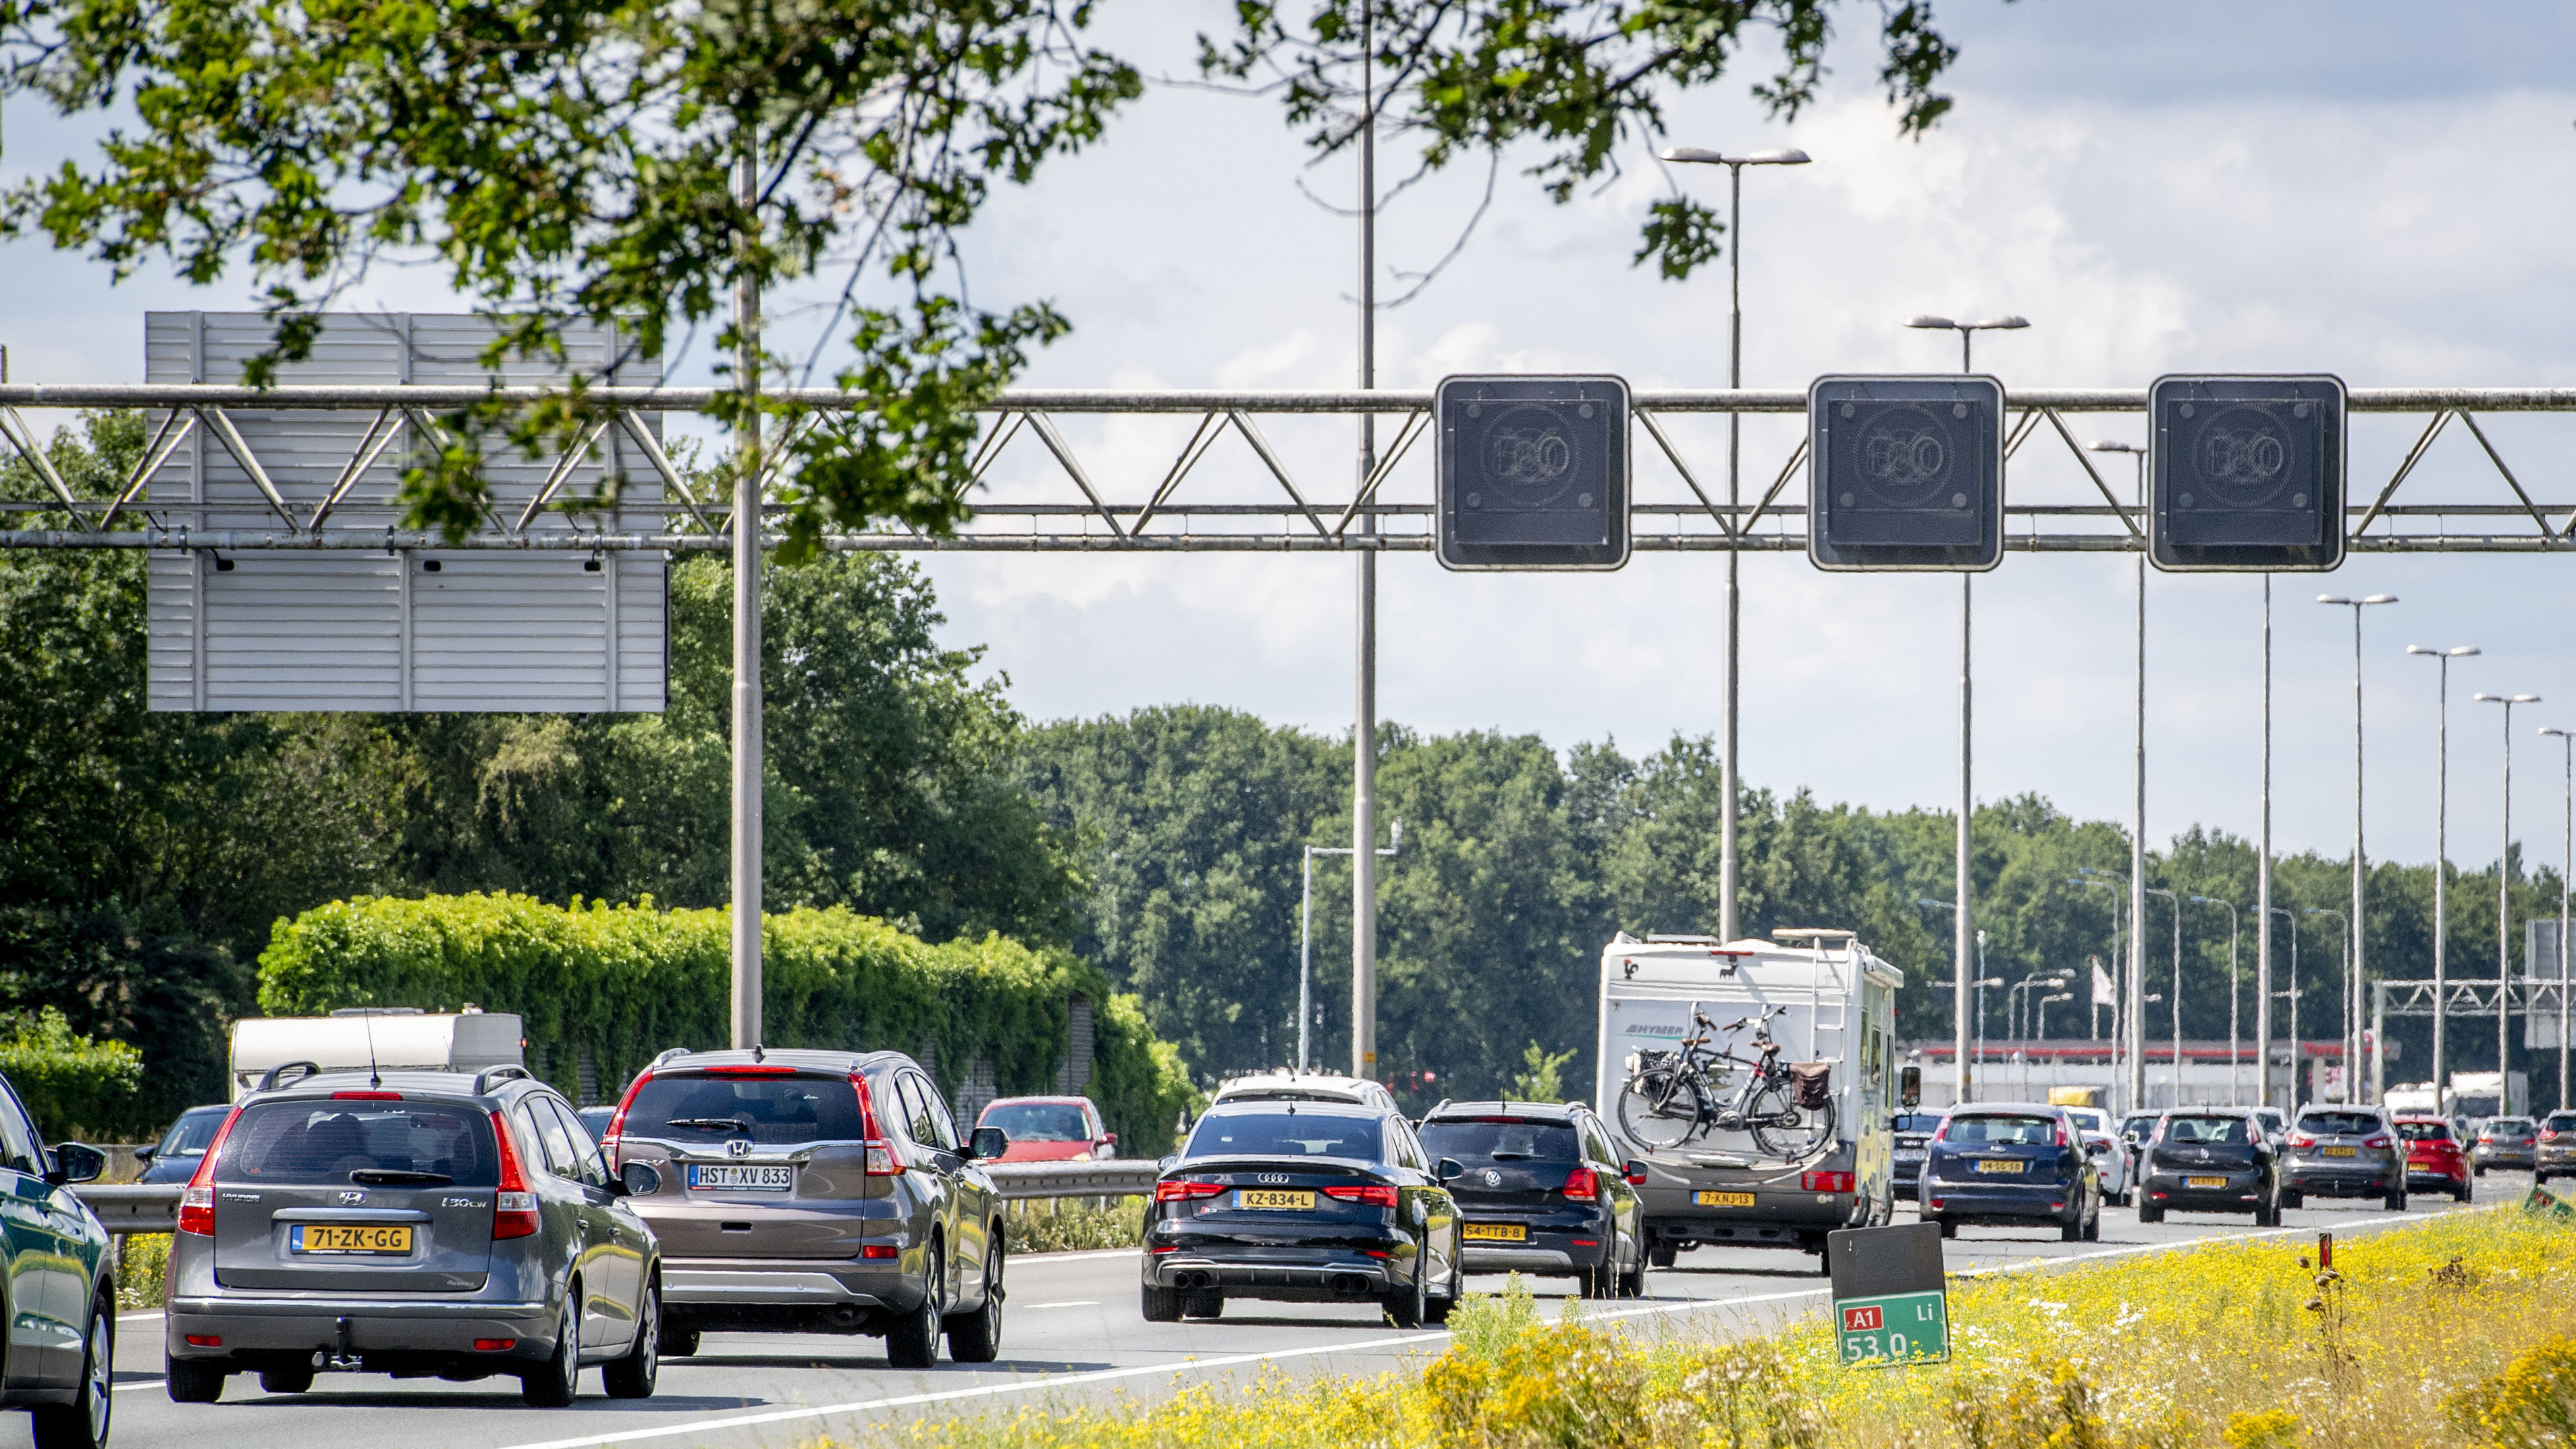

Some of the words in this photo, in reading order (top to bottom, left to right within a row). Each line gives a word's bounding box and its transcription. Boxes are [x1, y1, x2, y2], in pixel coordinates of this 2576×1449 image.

[1638, 1024, 1684, 1034] HYMER
[699, 1167, 728, 1184] HST
[739, 1168, 758, 1184] XV
[762, 1168, 789, 1184] 833
[1246, 1192, 1309, 1206] KZ-834-L
[1705, 1192, 1749, 1205] 7-KNJ-13
[313, 1228, 402, 1248] 71-ZK-GG
[1466, 1226, 1520, 1238] 54-TTB-8
[1853, 1309, 1874, 1327] A1
[1916, 1302, 1933, 1321] Li
